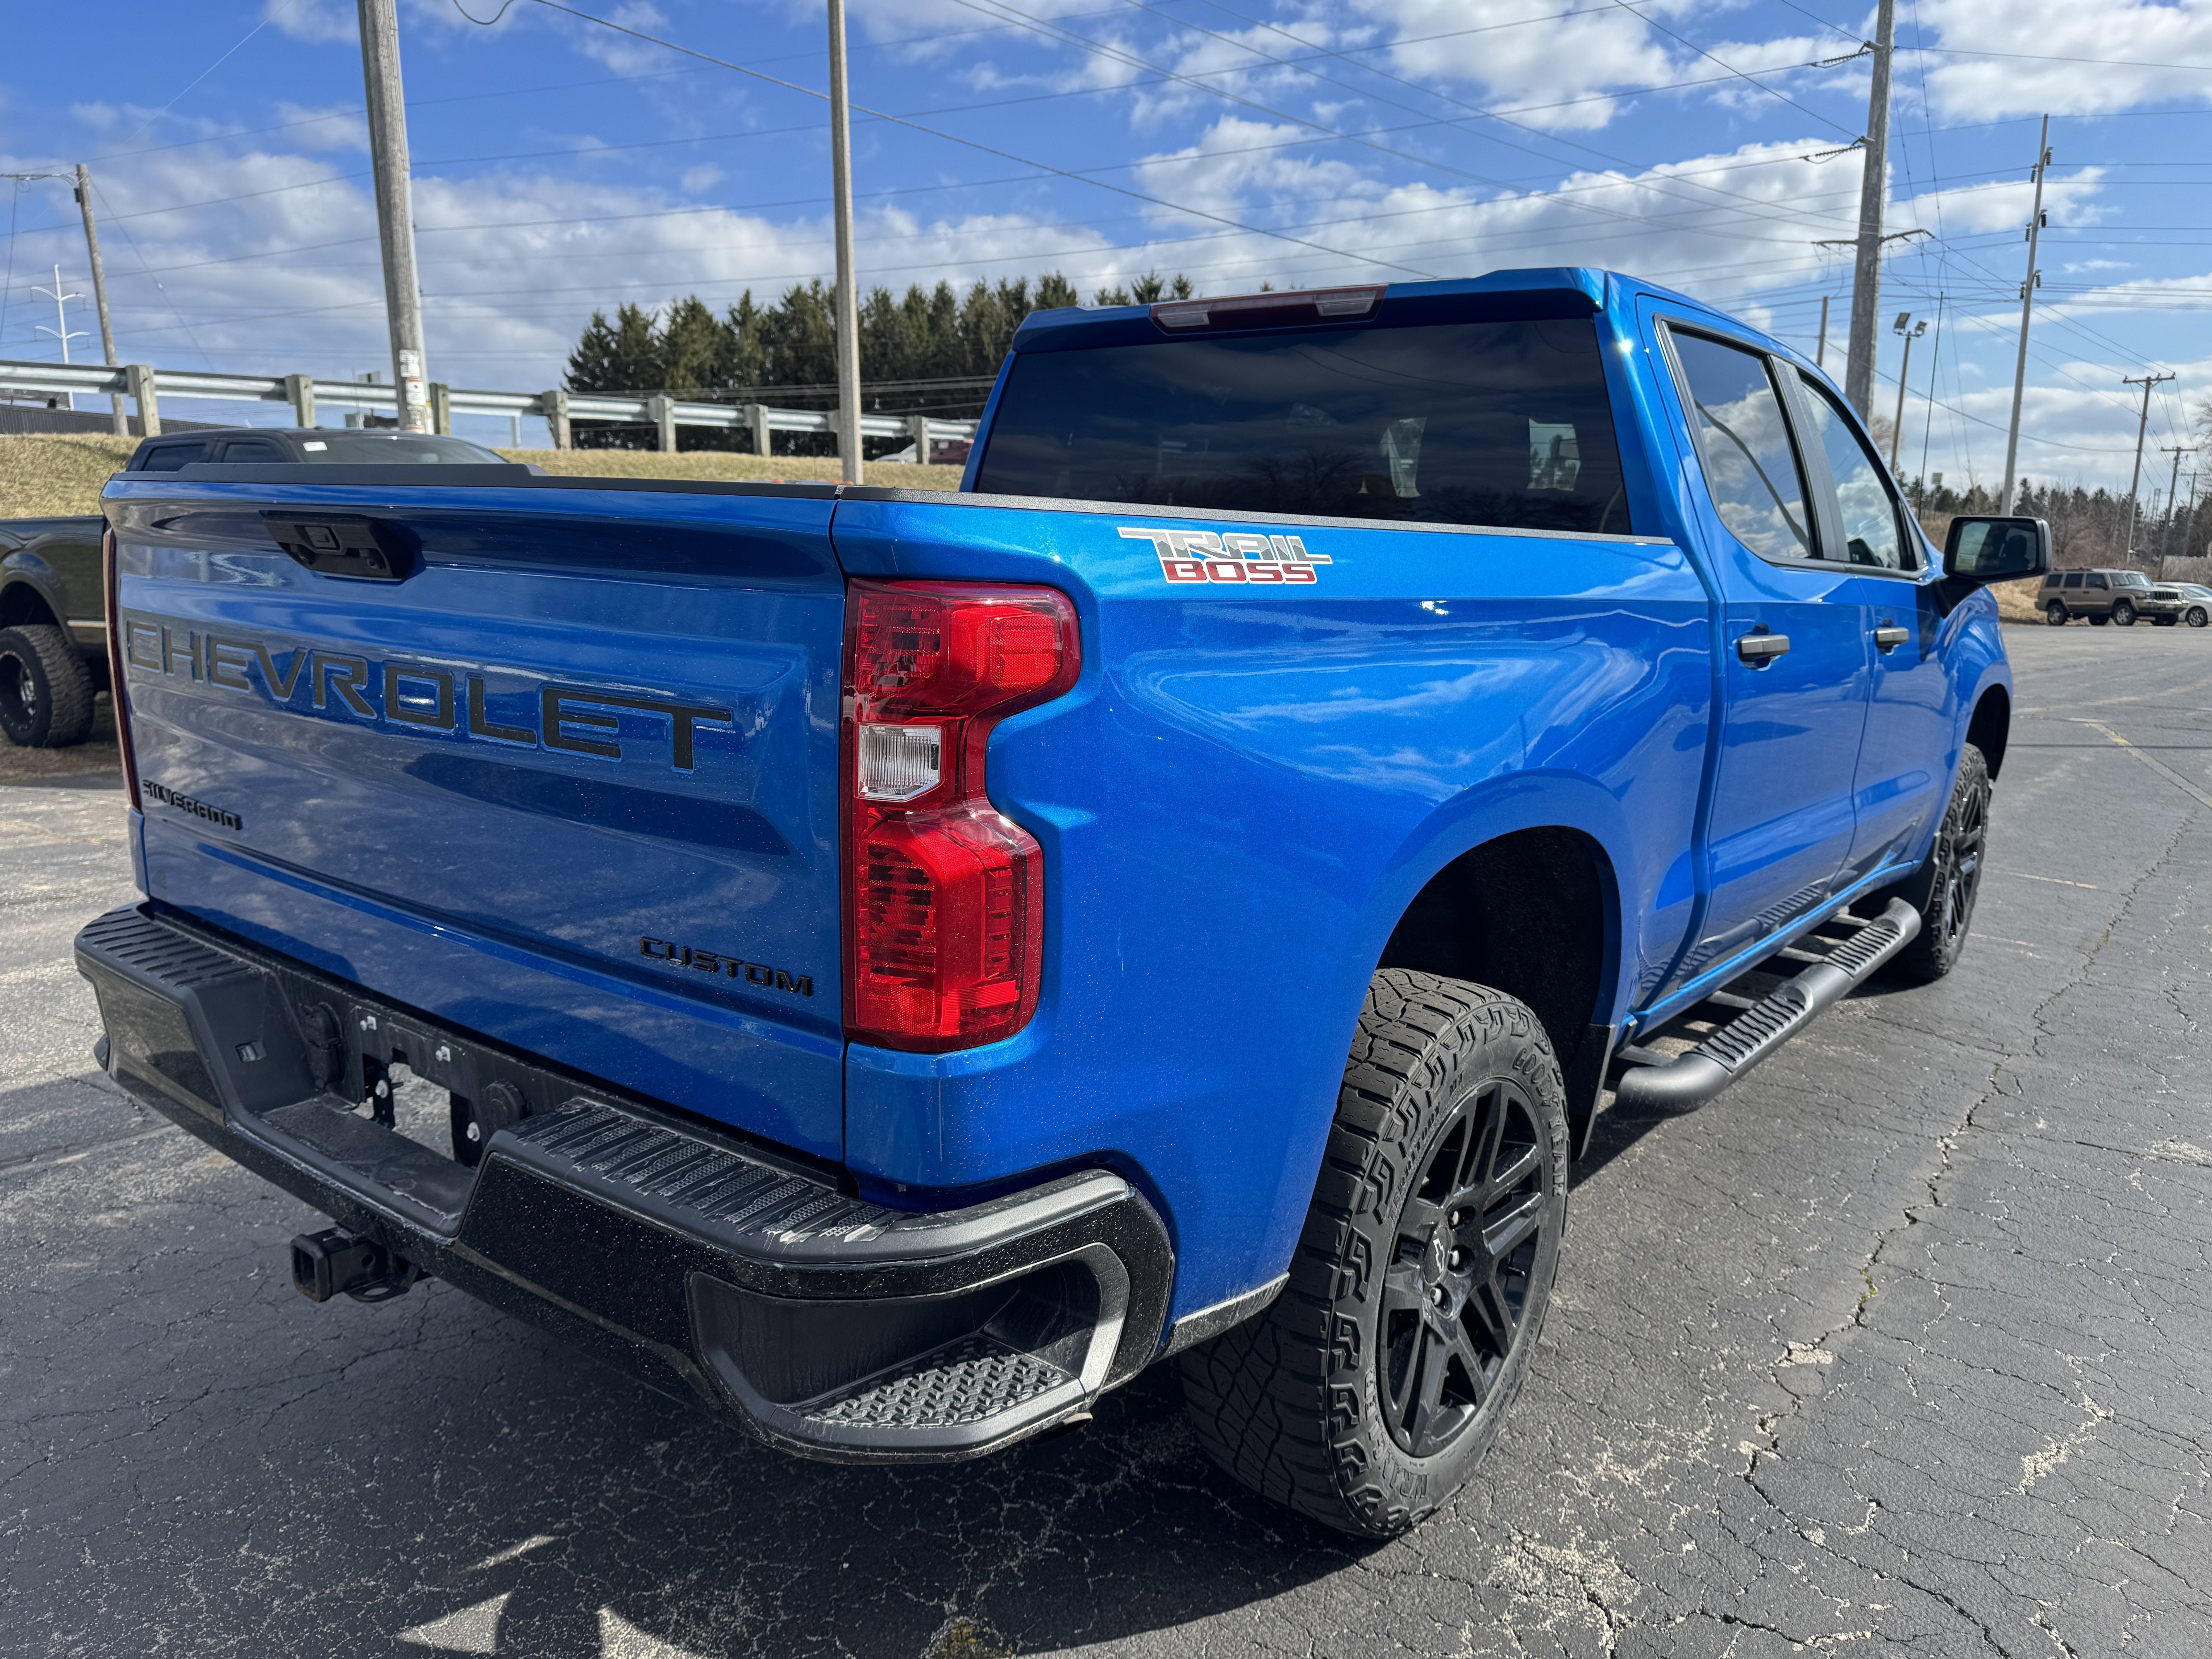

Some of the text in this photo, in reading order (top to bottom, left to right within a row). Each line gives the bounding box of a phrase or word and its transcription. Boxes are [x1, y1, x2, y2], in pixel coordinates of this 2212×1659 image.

[1117, 527, 1333, 565] TRAIL
[1162, 559, 1317, 584] BOSS
[127, 620, 732, 775] CHEVROLET
[639, 936, 813, 997] CUSTOM
[1513, 1048, 1565, 1197] GOODYEAR
